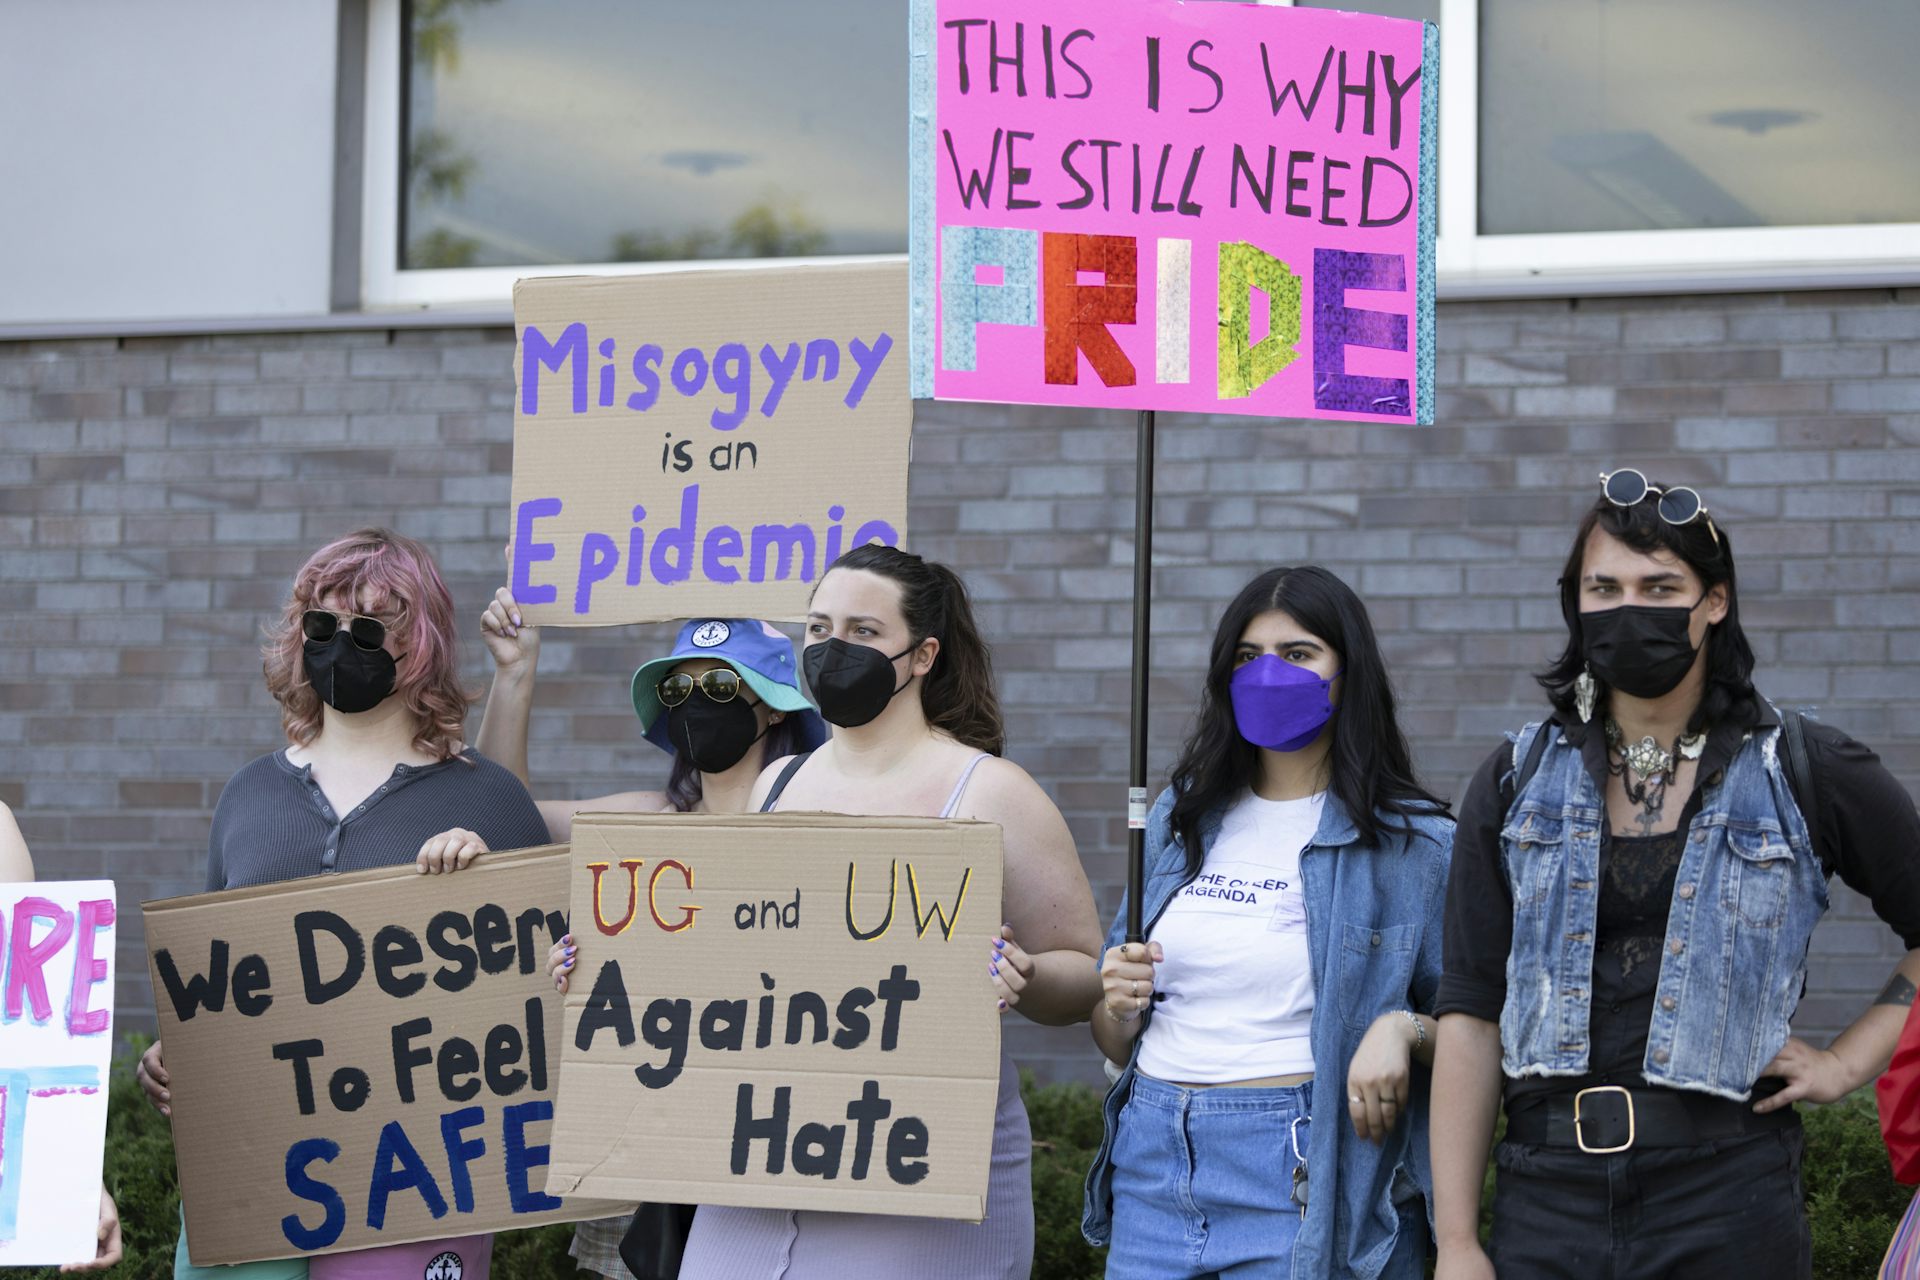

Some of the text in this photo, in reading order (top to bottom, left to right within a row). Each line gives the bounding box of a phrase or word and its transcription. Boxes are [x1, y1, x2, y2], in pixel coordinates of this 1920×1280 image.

[945, 19, 1421, 150] THIS IS WHY
[943, 128, 1413, 227] WE STILL NEED
[941, 226, 1411, 417] PRIDE
[522, 322, 893, 431] Misogyny
[662, 432, 757, 473] is an
[587, 859, 972, 942] UG and UW
[1184, 885, 1257, 904] AGENDA
[0, 896, 116, 1038] RE
[154, 940, 273, 1022] We
[273, 997, 548, 1115] To Feel
[575, 960, 920, 1089] Against
[281, 1101, 563, 1251] SAFE
[730, 1080, 930, 1185] Hate
